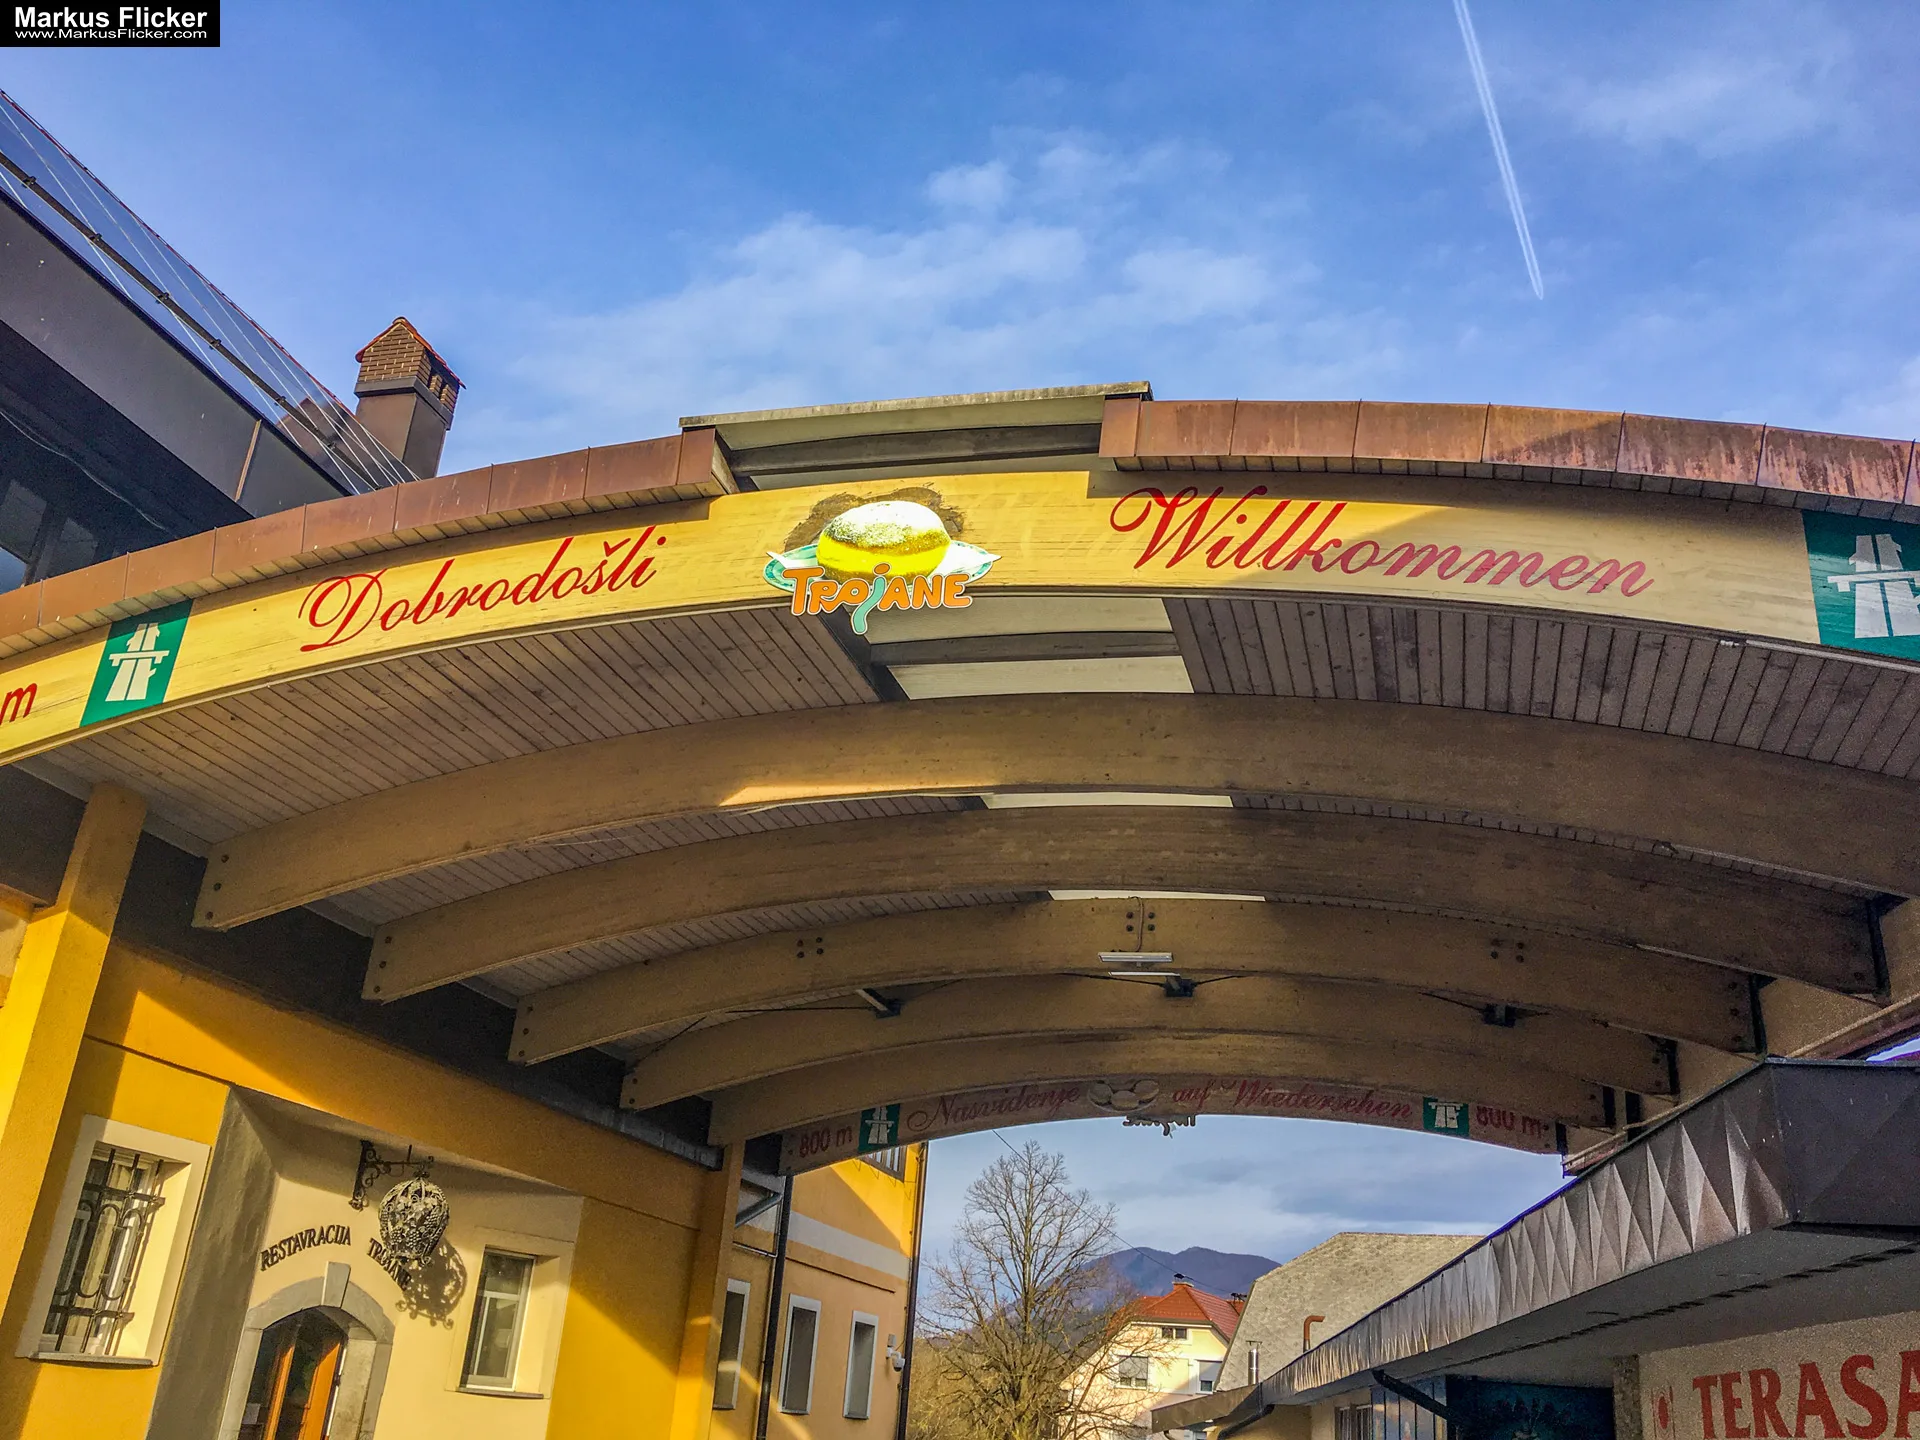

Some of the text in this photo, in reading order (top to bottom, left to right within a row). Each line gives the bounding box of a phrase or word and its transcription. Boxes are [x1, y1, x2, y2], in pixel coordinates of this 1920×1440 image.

[1109, 485, 1655, 598] Willkommen
[298, 525, 667, 653] Dobrodošli
[799, 1128, 831, 1158] 800
[260, 1224, 351, 1272] RESTAVRACIJA
